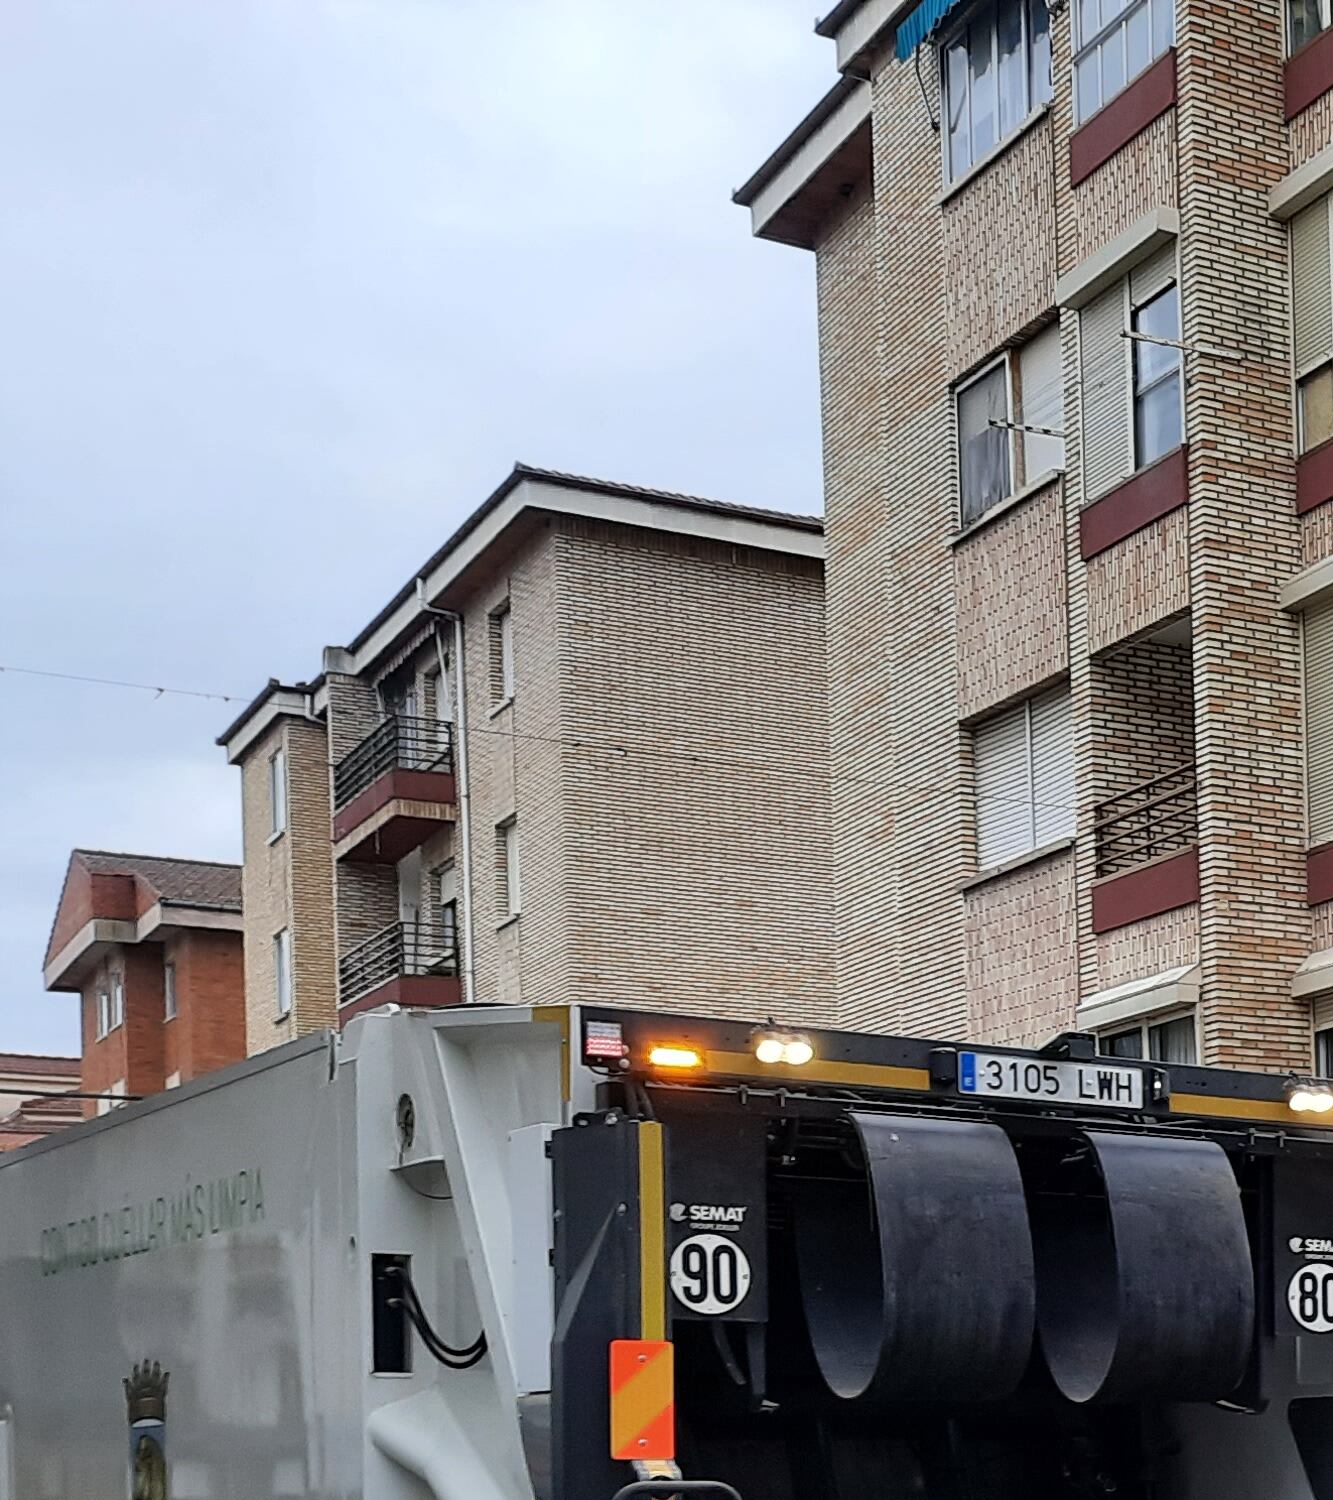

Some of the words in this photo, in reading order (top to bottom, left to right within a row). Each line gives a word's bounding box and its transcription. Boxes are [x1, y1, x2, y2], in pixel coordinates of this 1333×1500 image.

[963, 1076, 974, 1087] E
[986, 1060, 1060, 1096] 3105
[1078, 1068, 1133, 1103] LWH
[690, 1205, 748, 1222] SEMAT
[682, 1244, 738, 1305] 90
